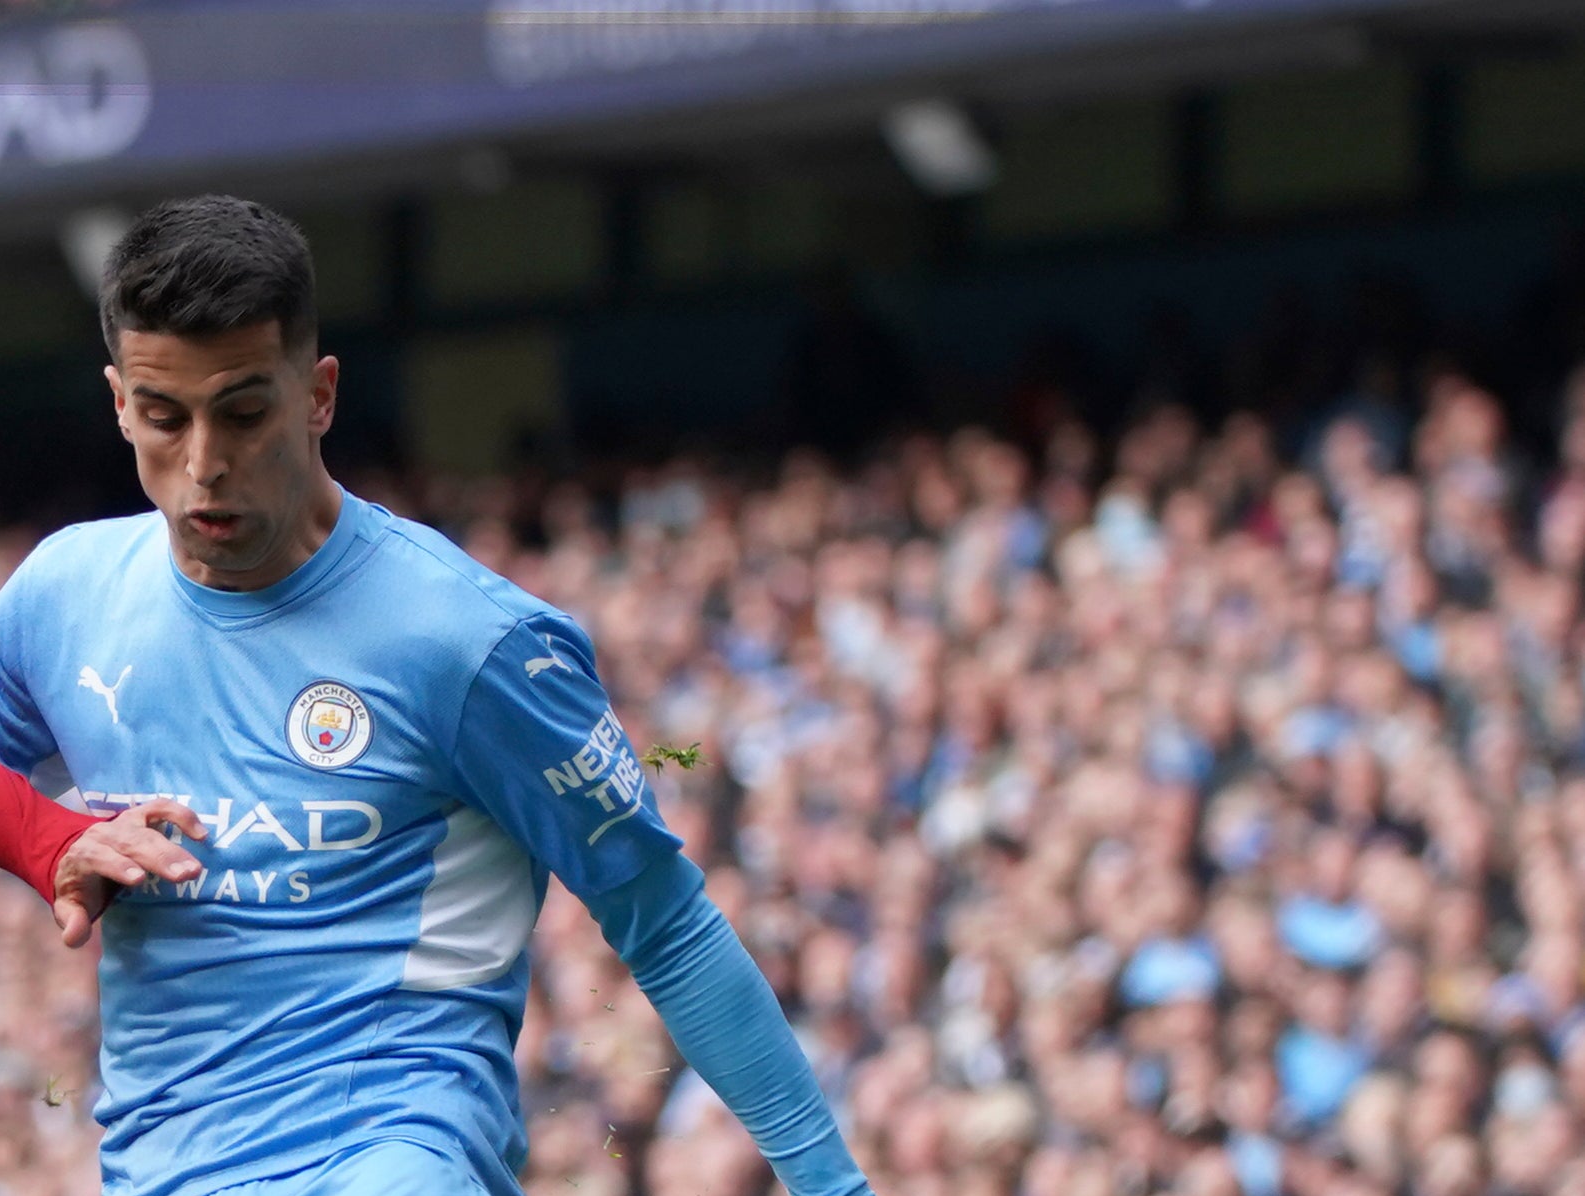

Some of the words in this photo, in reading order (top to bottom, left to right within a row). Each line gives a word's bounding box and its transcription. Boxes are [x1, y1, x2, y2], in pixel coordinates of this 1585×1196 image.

[300, 686, 366, 720] MANCHESTER
[309, 753, 334, 765] CITY
[543, 703, 623, 796] NEXEN
[585, 747, 641, 813] TIRE
